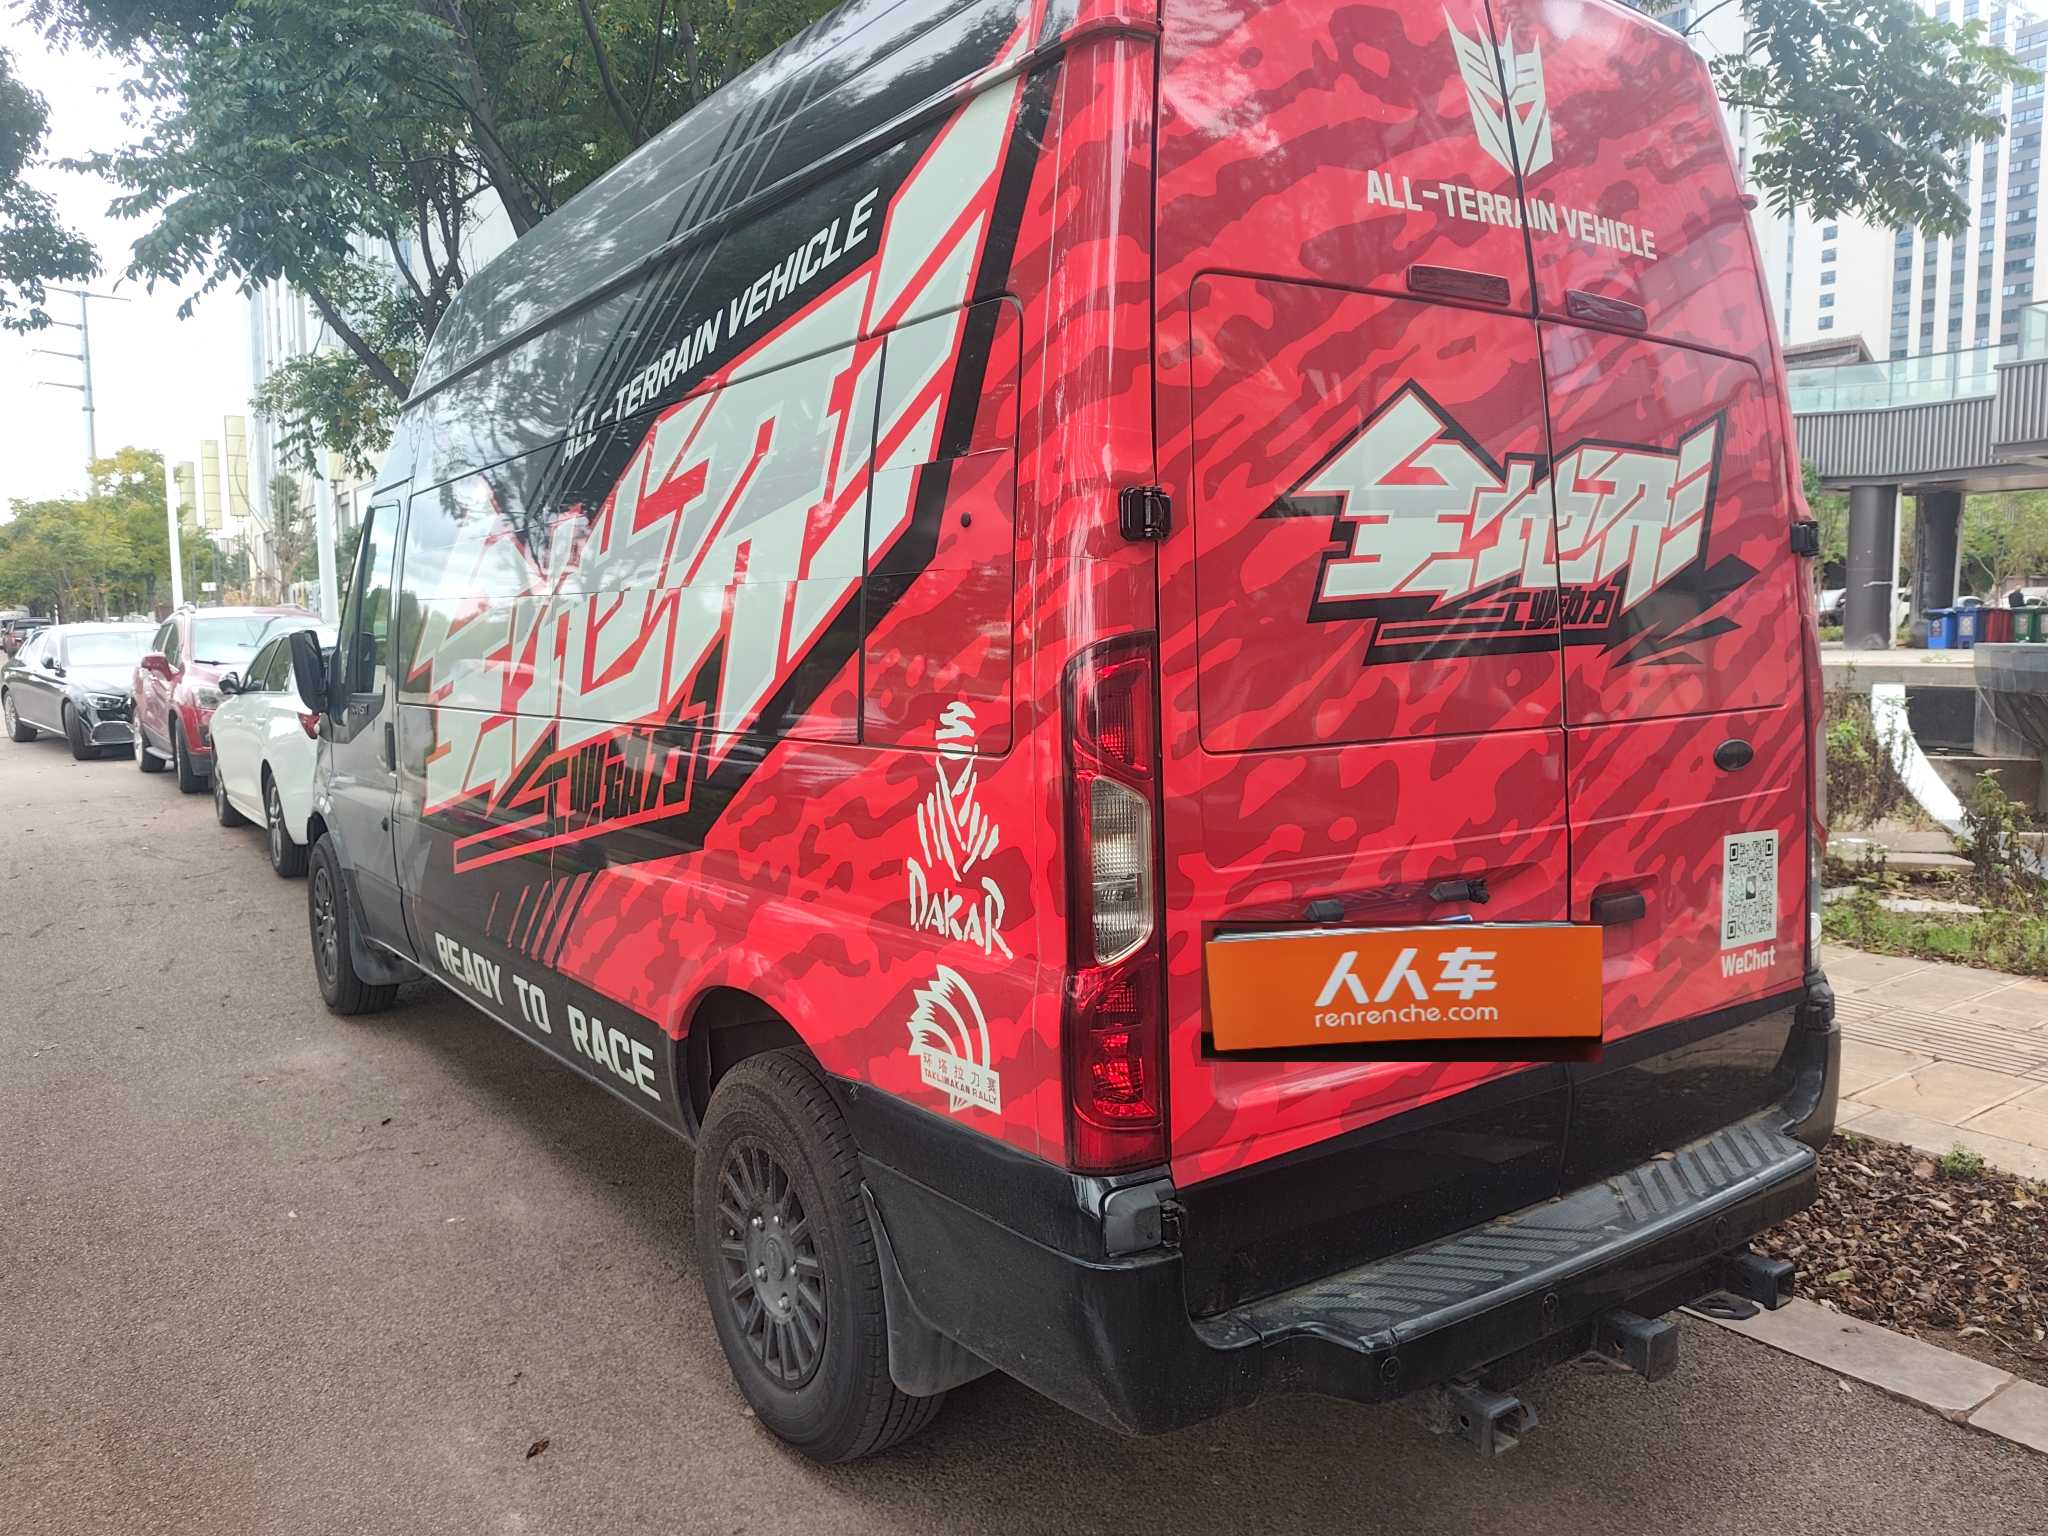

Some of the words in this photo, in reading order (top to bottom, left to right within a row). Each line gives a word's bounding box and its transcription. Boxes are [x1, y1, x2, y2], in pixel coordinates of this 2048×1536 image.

[1367, 169, 1559, 234] ALL-TERRAIN
[1561, 206, 1658, 260] VEHICLE
[561, 308, 724, 466] ALL-TERRAIN
[728, 187, 879, 339] VEHICLE
[408, 26, 1032, 814] 全地形
[1303, 391, 1717, 608] 全地形
[907, 857, 1013, 960] DAKAR
[1721, 946, 1776, 978] WeChat
[434, 932, 504, 1006] READY
[513, 974, 552, 1034] TO
[567, 1004, 661, 1102] RACE
[972, 1088, 997, 1105] RALLY
